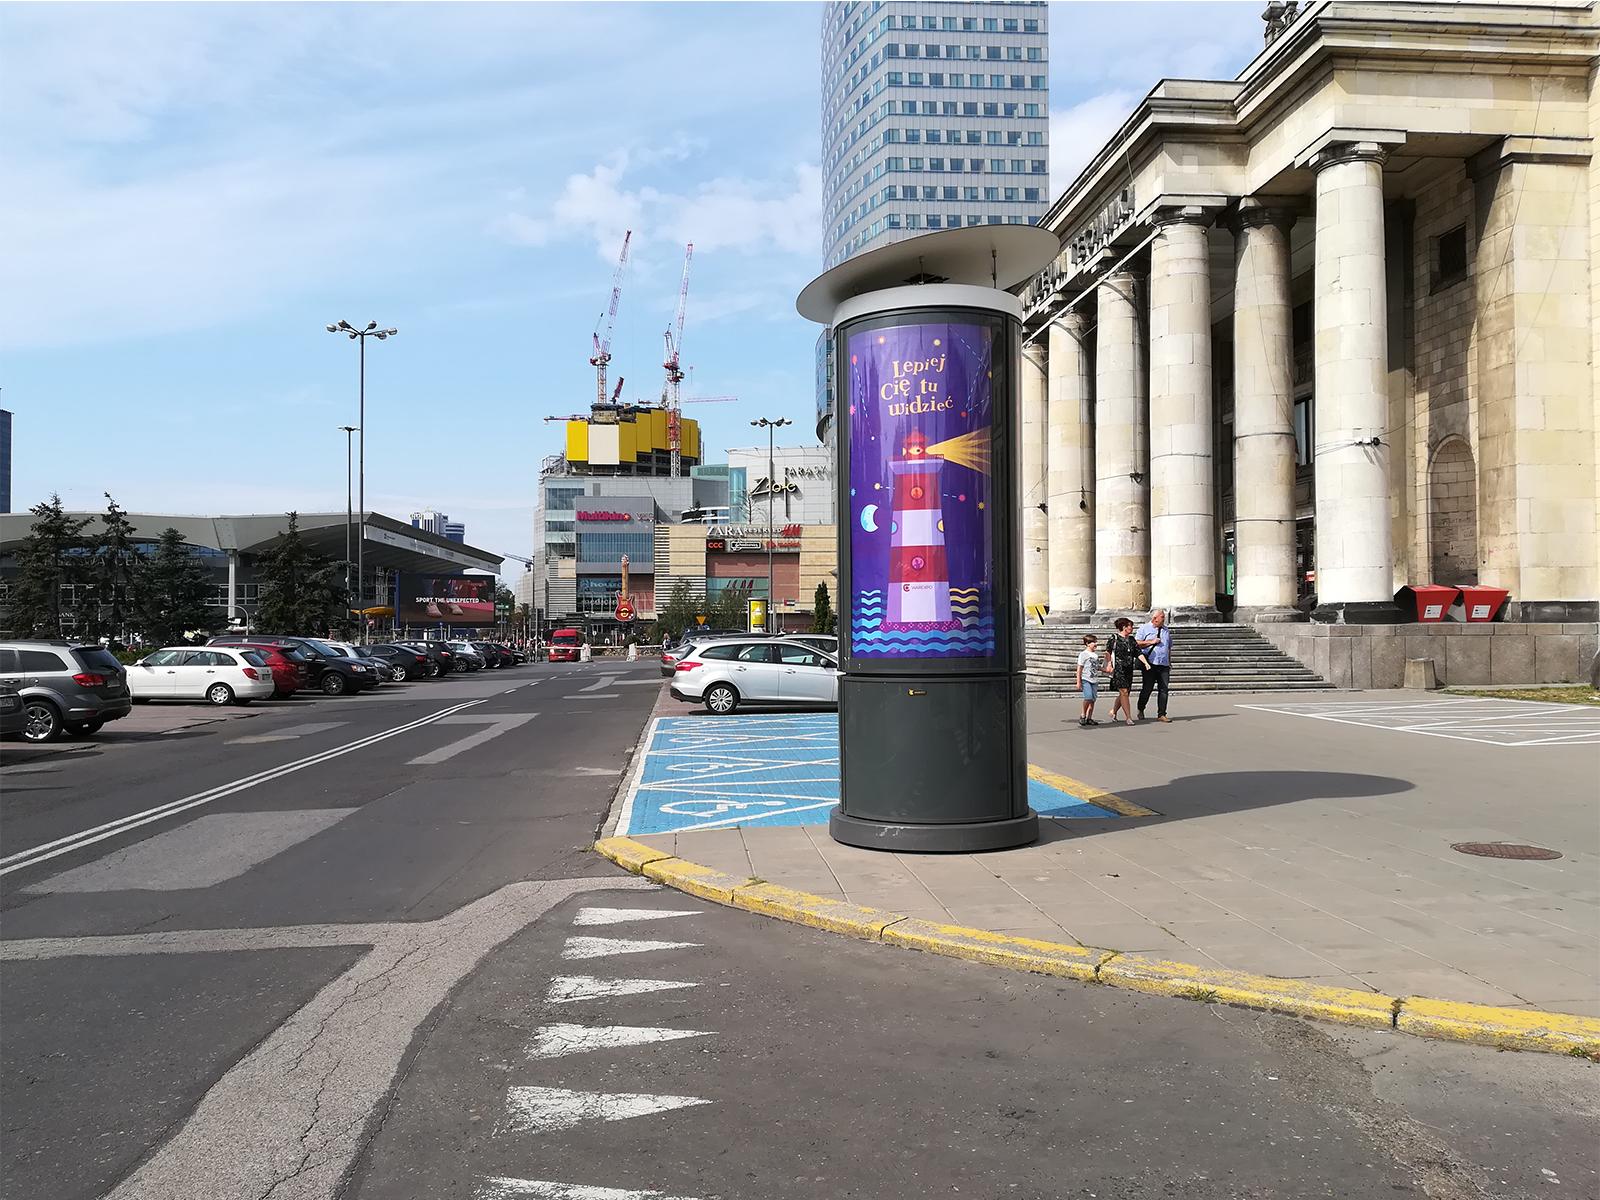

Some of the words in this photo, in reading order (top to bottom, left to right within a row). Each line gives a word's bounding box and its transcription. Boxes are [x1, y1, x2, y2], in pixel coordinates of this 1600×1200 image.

[892, 353, 946, 378] Lepiej
[880, 379, 911, 400] Cię
[920, 379, 938, 394] tu
[888, 395, 954, 416] widzieć
[706, 525, 743, 536] ZARA
